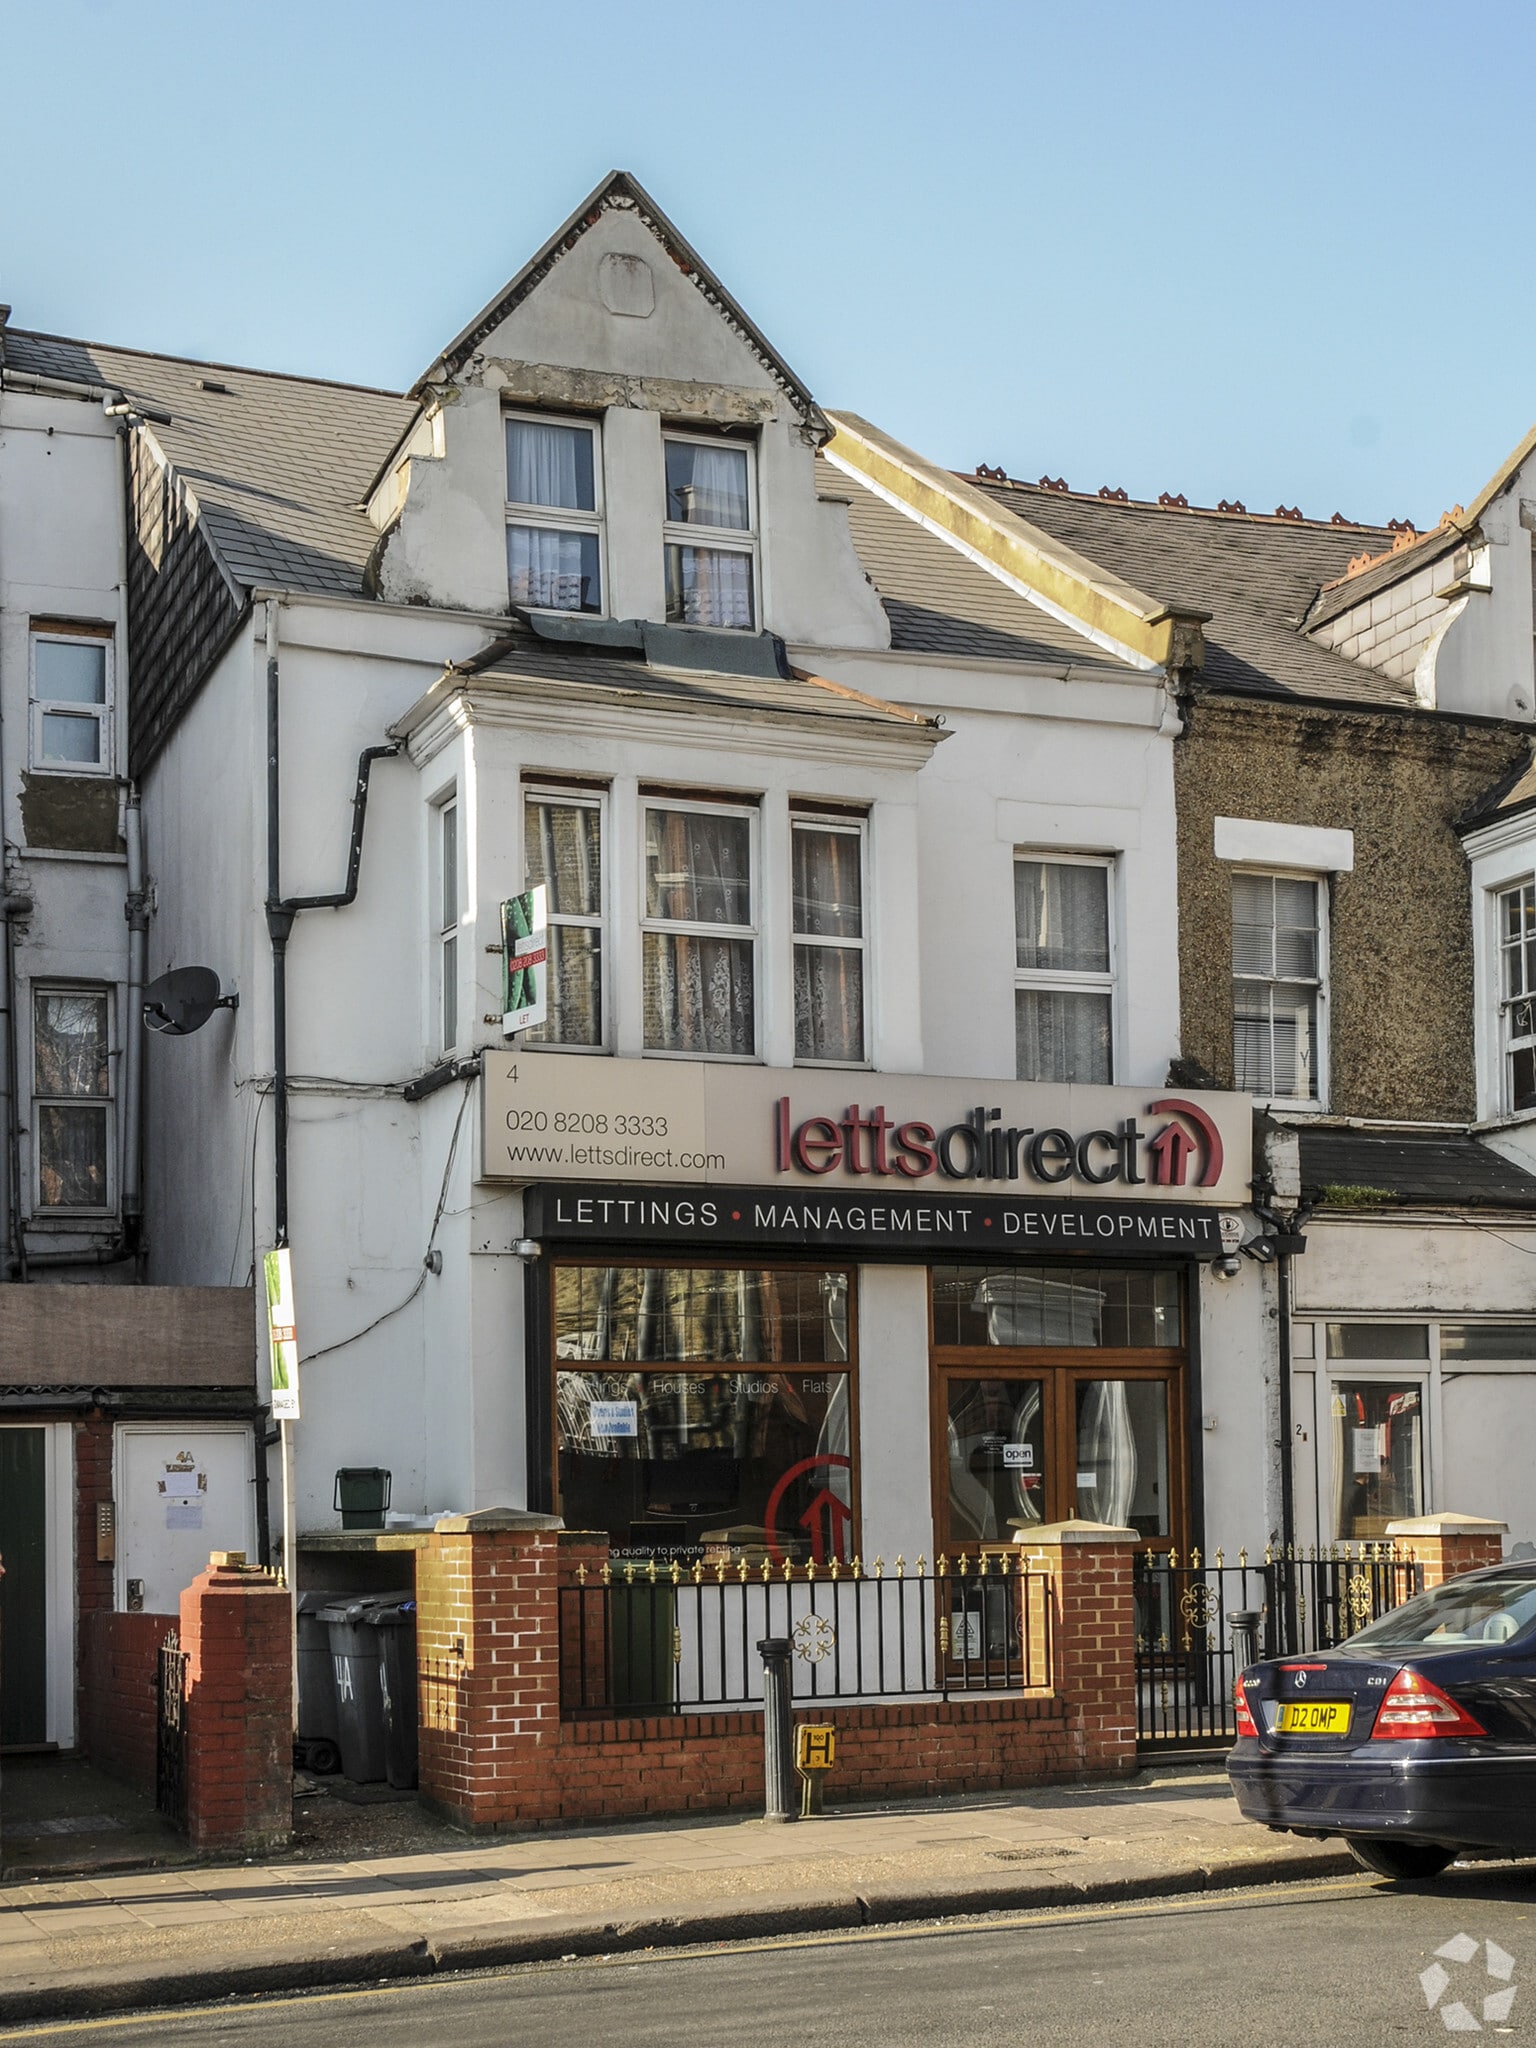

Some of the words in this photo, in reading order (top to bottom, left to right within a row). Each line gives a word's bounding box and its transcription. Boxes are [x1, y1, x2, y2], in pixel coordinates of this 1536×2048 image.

[519, 1013, 529, 1024] LET
[506, 1064, 519, 1084] 4
[506, 1110, 548, 1132] 020
[554, 1112, 608, 1134] 8208
[614, 1115, 668, 1137] 3333
[776, 1096, 1146, 1184] lettsdirect
[507, 1144, 726, 1170] www.lettsdirect.com
[556, 1199, 718, 1226] LETTINGS
[754, 1205, 972, 1232] MANAGEMENT
[1003, 1212, 1212, 1239] DEVELOPMENT
[653, 1380, 705, 1395] Houses
[729, 1379, 779, 1394] Studios
[802, 1379, 832, 1394] Flats
[1296, 1424, 1302, 1435] 2
[176, 1451, 194, 1463] 4A
[1005, 1450, 1031, 1460] open
[609, 1548, 620, 1558] ng
[622, 1546, 658, 1557] quality
[658, 1546, 668, 1555] to
[669, 1545, 705, 1557] private
[335, 1655, 353, 1702] 4A
[1367, 1677, 1386, 1685] CDI
[1291, 1706, 1308, 1728] D2
[1311, 1706, 1337, 1729] OMP
